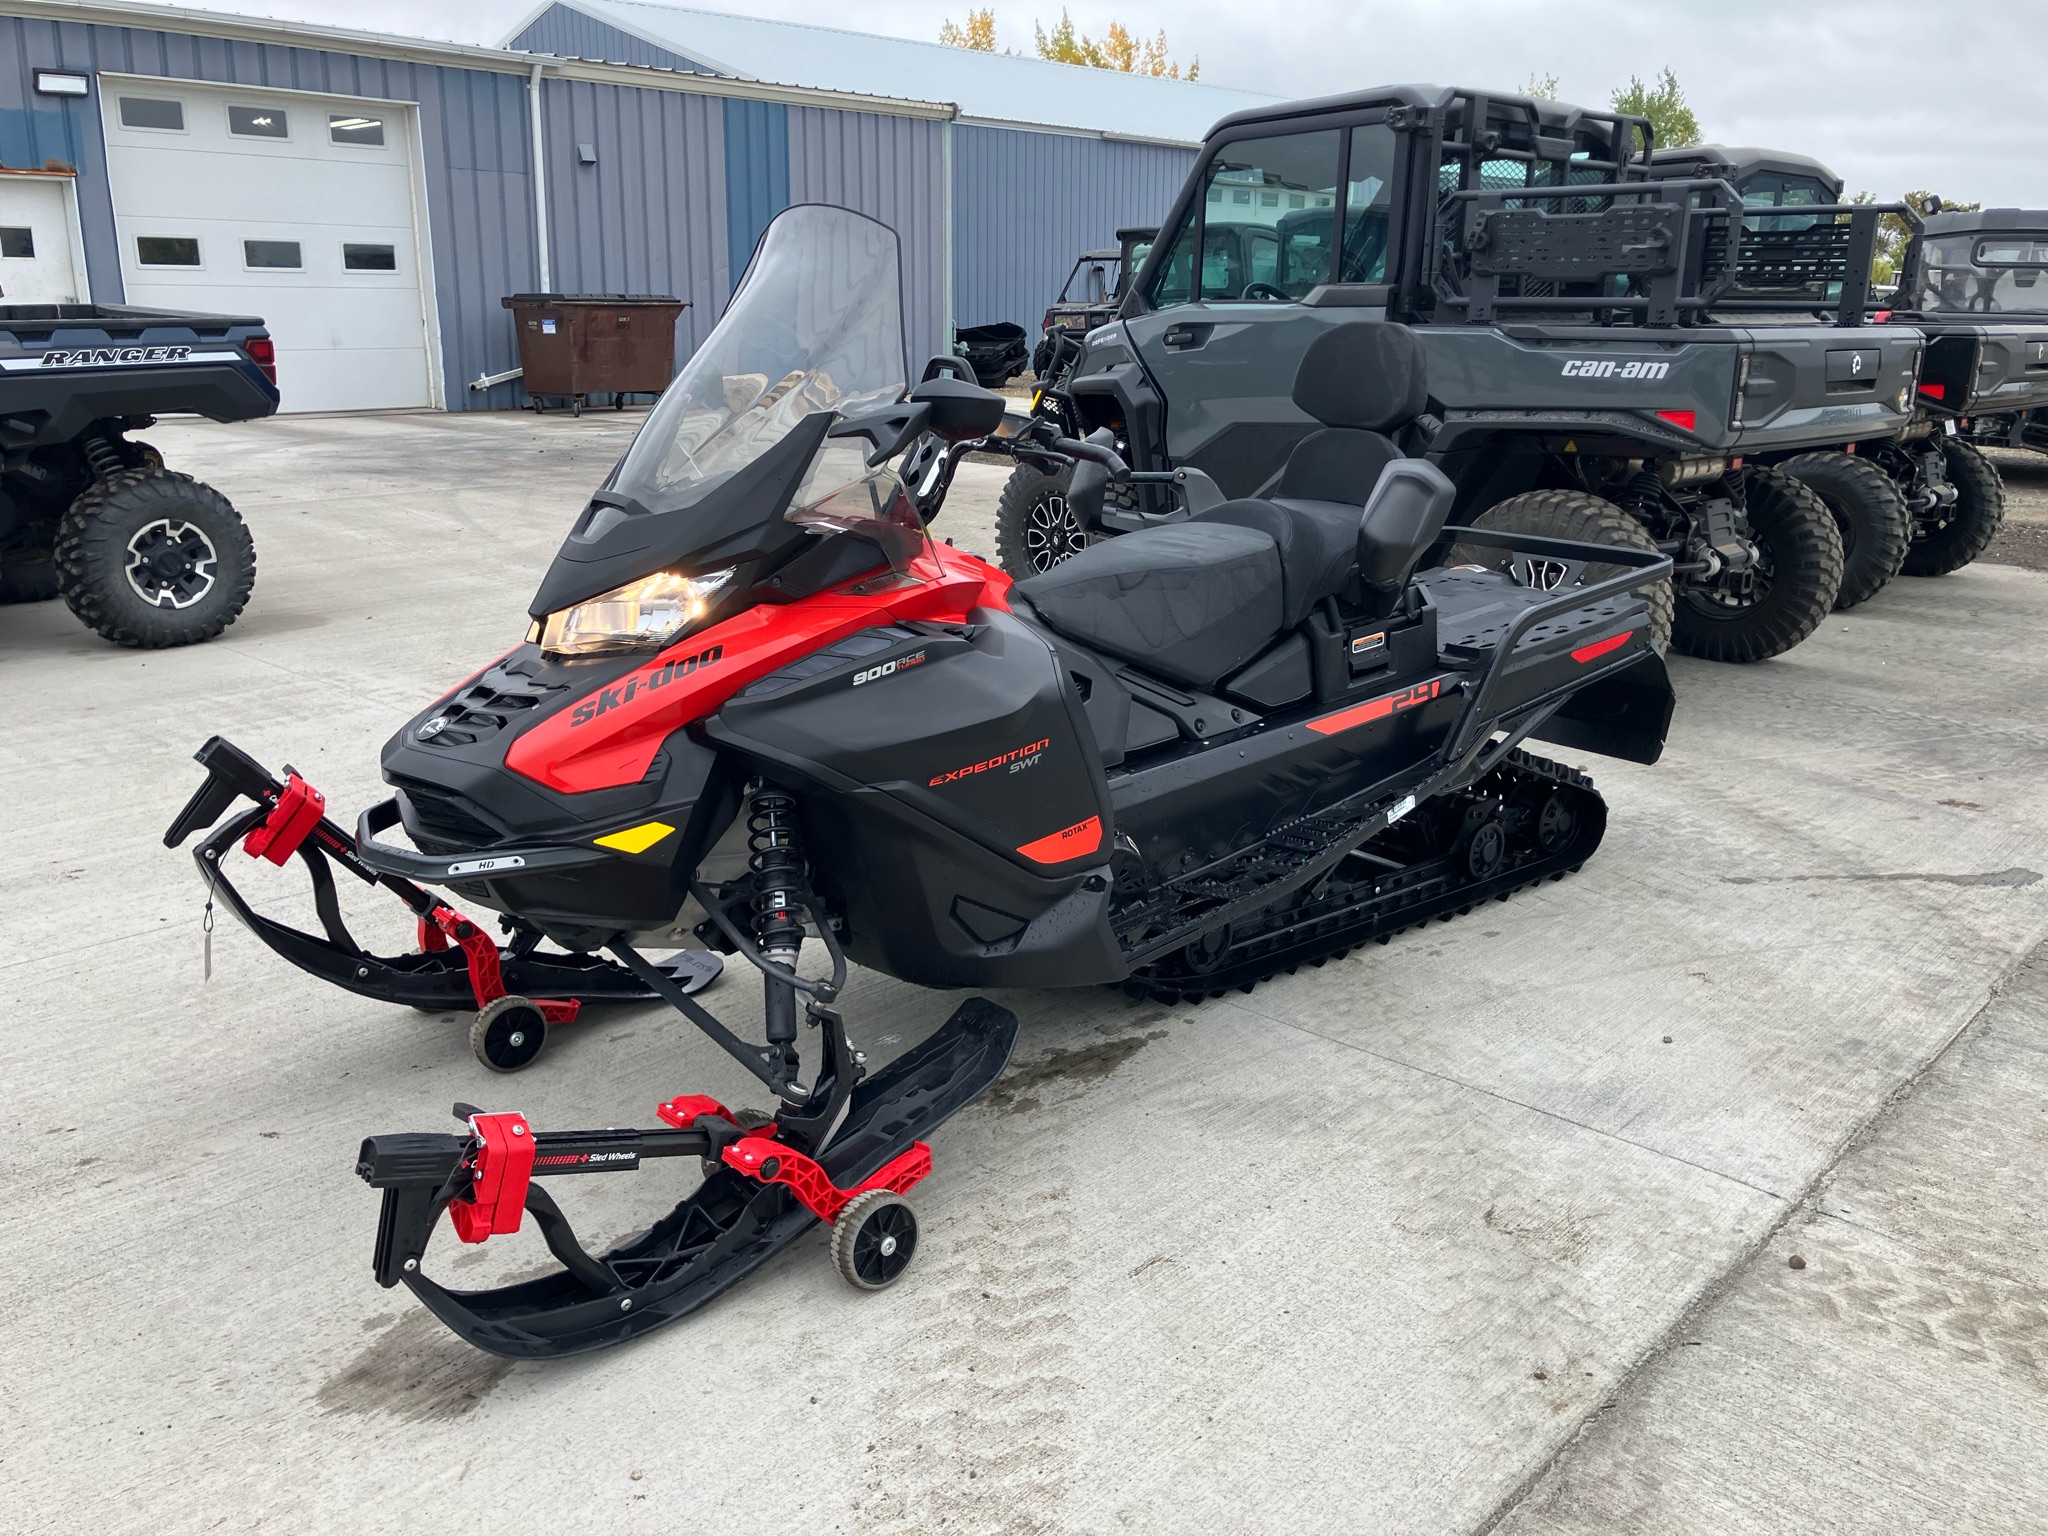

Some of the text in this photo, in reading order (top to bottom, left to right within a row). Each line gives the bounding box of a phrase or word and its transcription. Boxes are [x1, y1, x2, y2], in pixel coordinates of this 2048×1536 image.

[1091, 333, 1117, 346] DEFENDER
[39, 346, 192, 367] RANGER
[1561, 360, 1670, 379] can-am
[852, 650, 926, 686] 900 ACE
[928, 738, 1050, 787] EXPEDITION
[1009, 753, 1042, 774] SWT
[1061, 822, 1088, 840] ROTAX
[478, 860, 495, 870] HD
[588, 1151, 638, 1162] Sled Wheels
